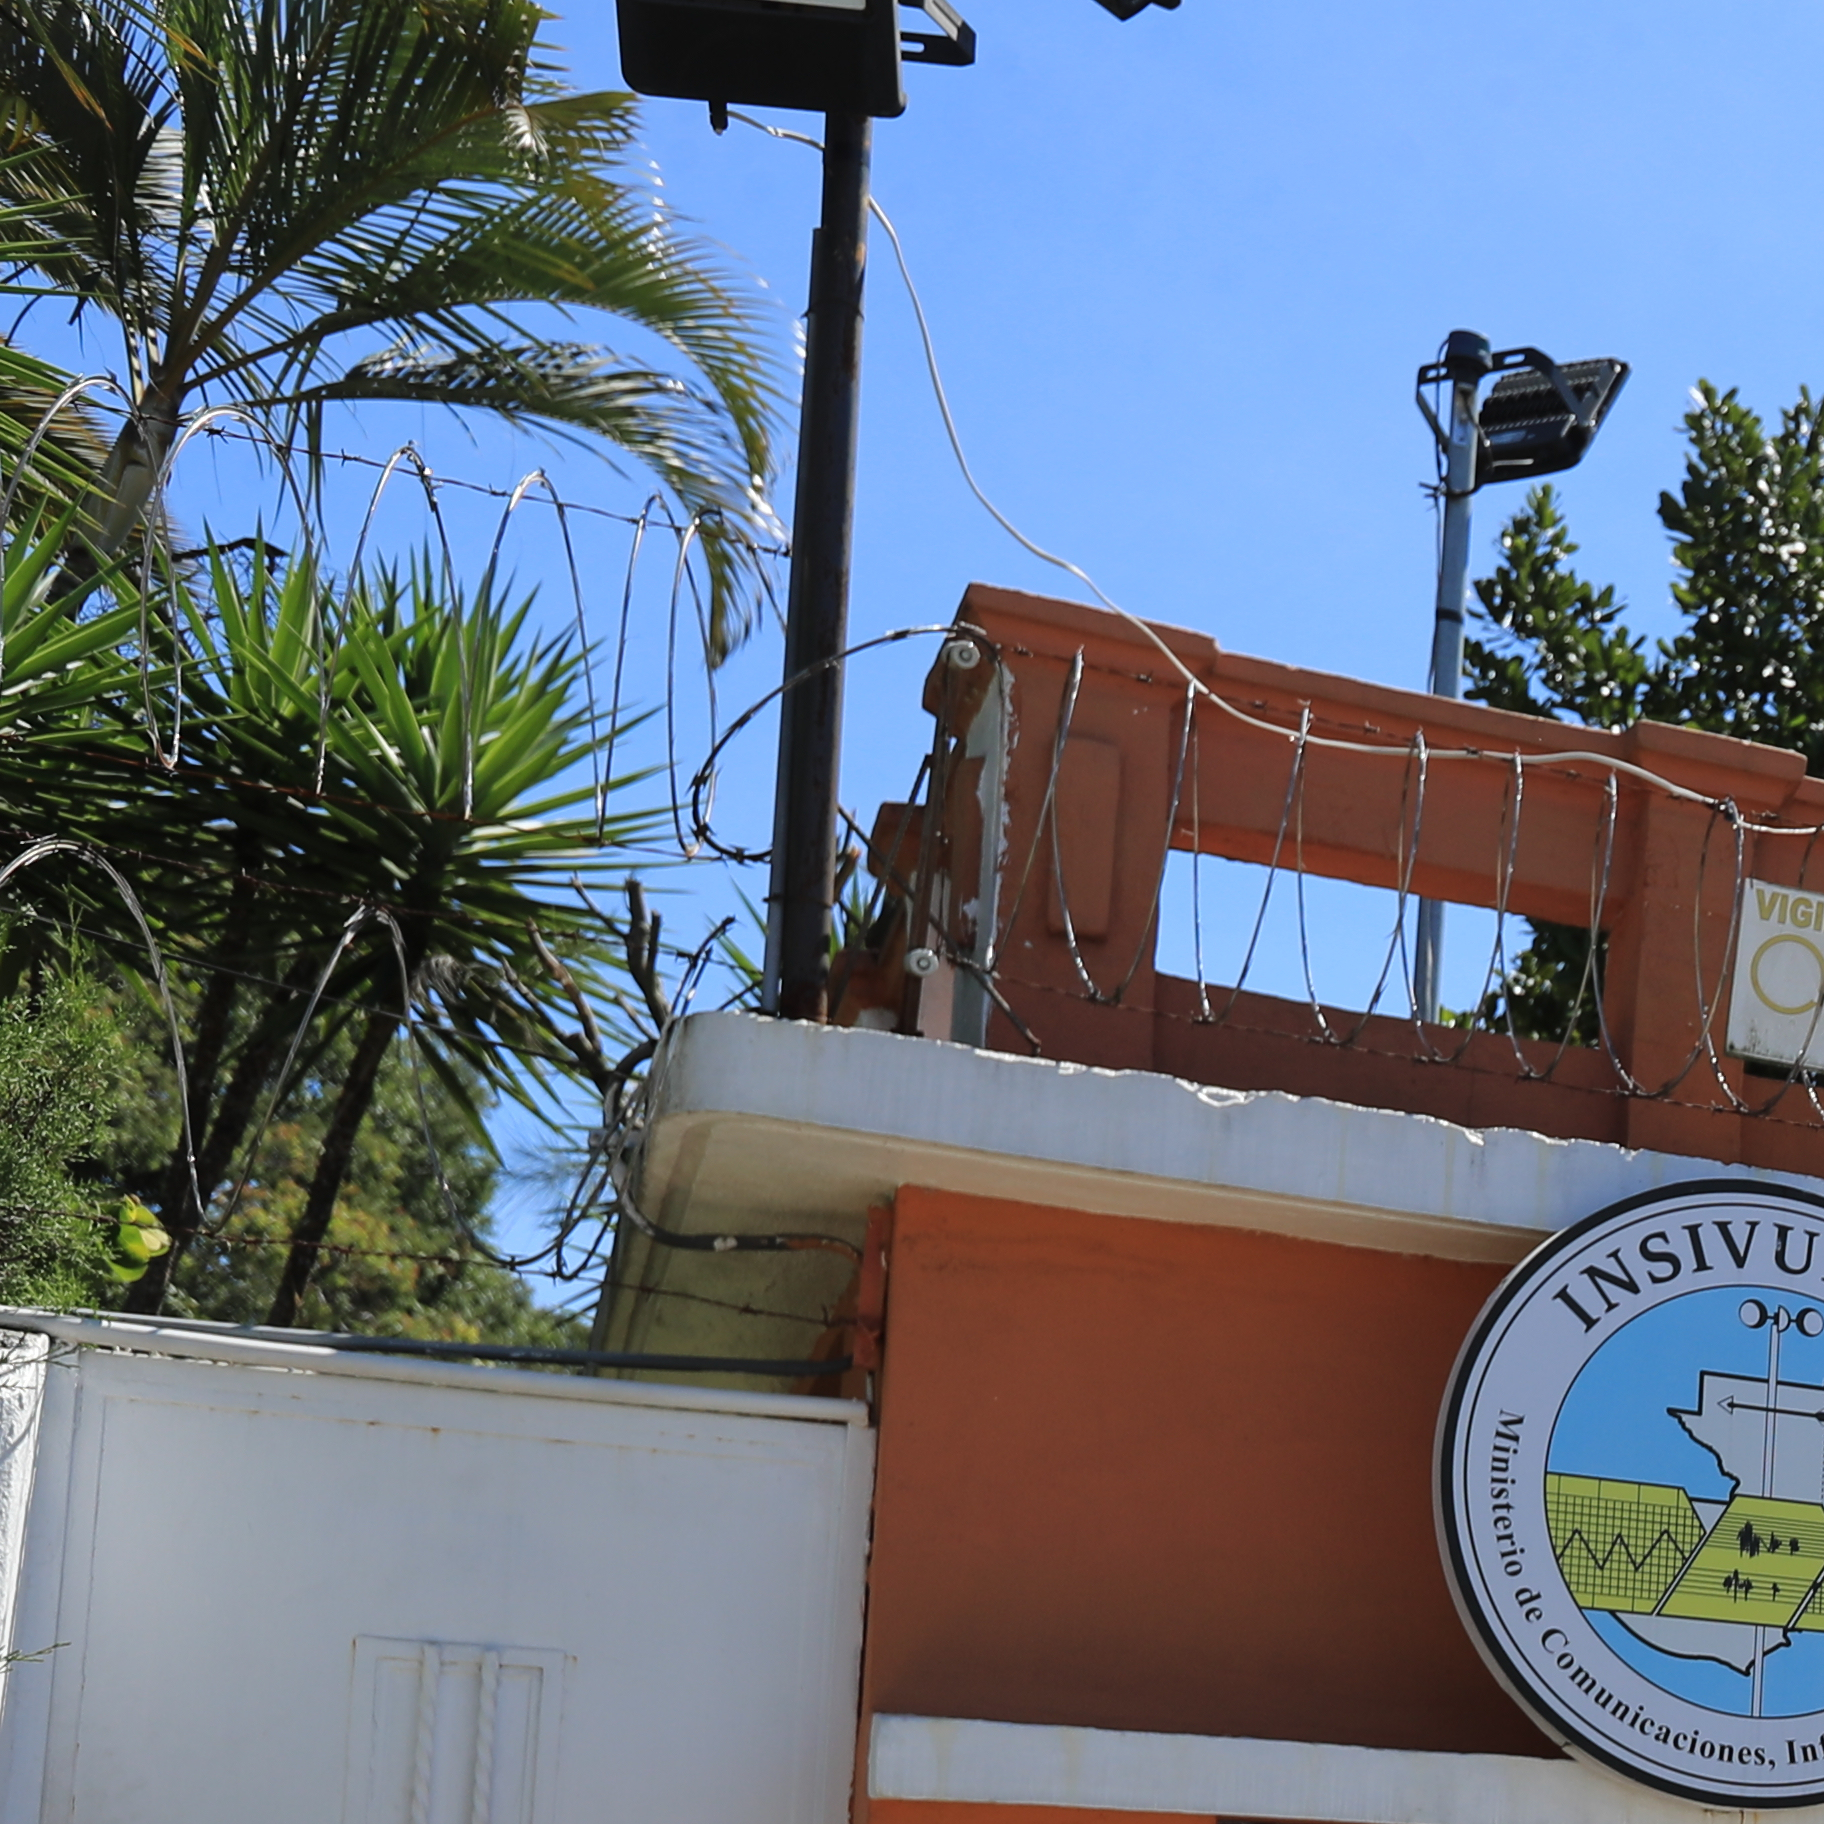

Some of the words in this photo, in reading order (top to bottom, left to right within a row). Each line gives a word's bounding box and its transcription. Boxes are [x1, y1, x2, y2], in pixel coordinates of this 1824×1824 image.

[1490, 1408, 1526, 1577] Ministerio
[1514, 1586, 1544, 1623] de
[1540, 1627, 1777, 1770] Comunicaciones,
